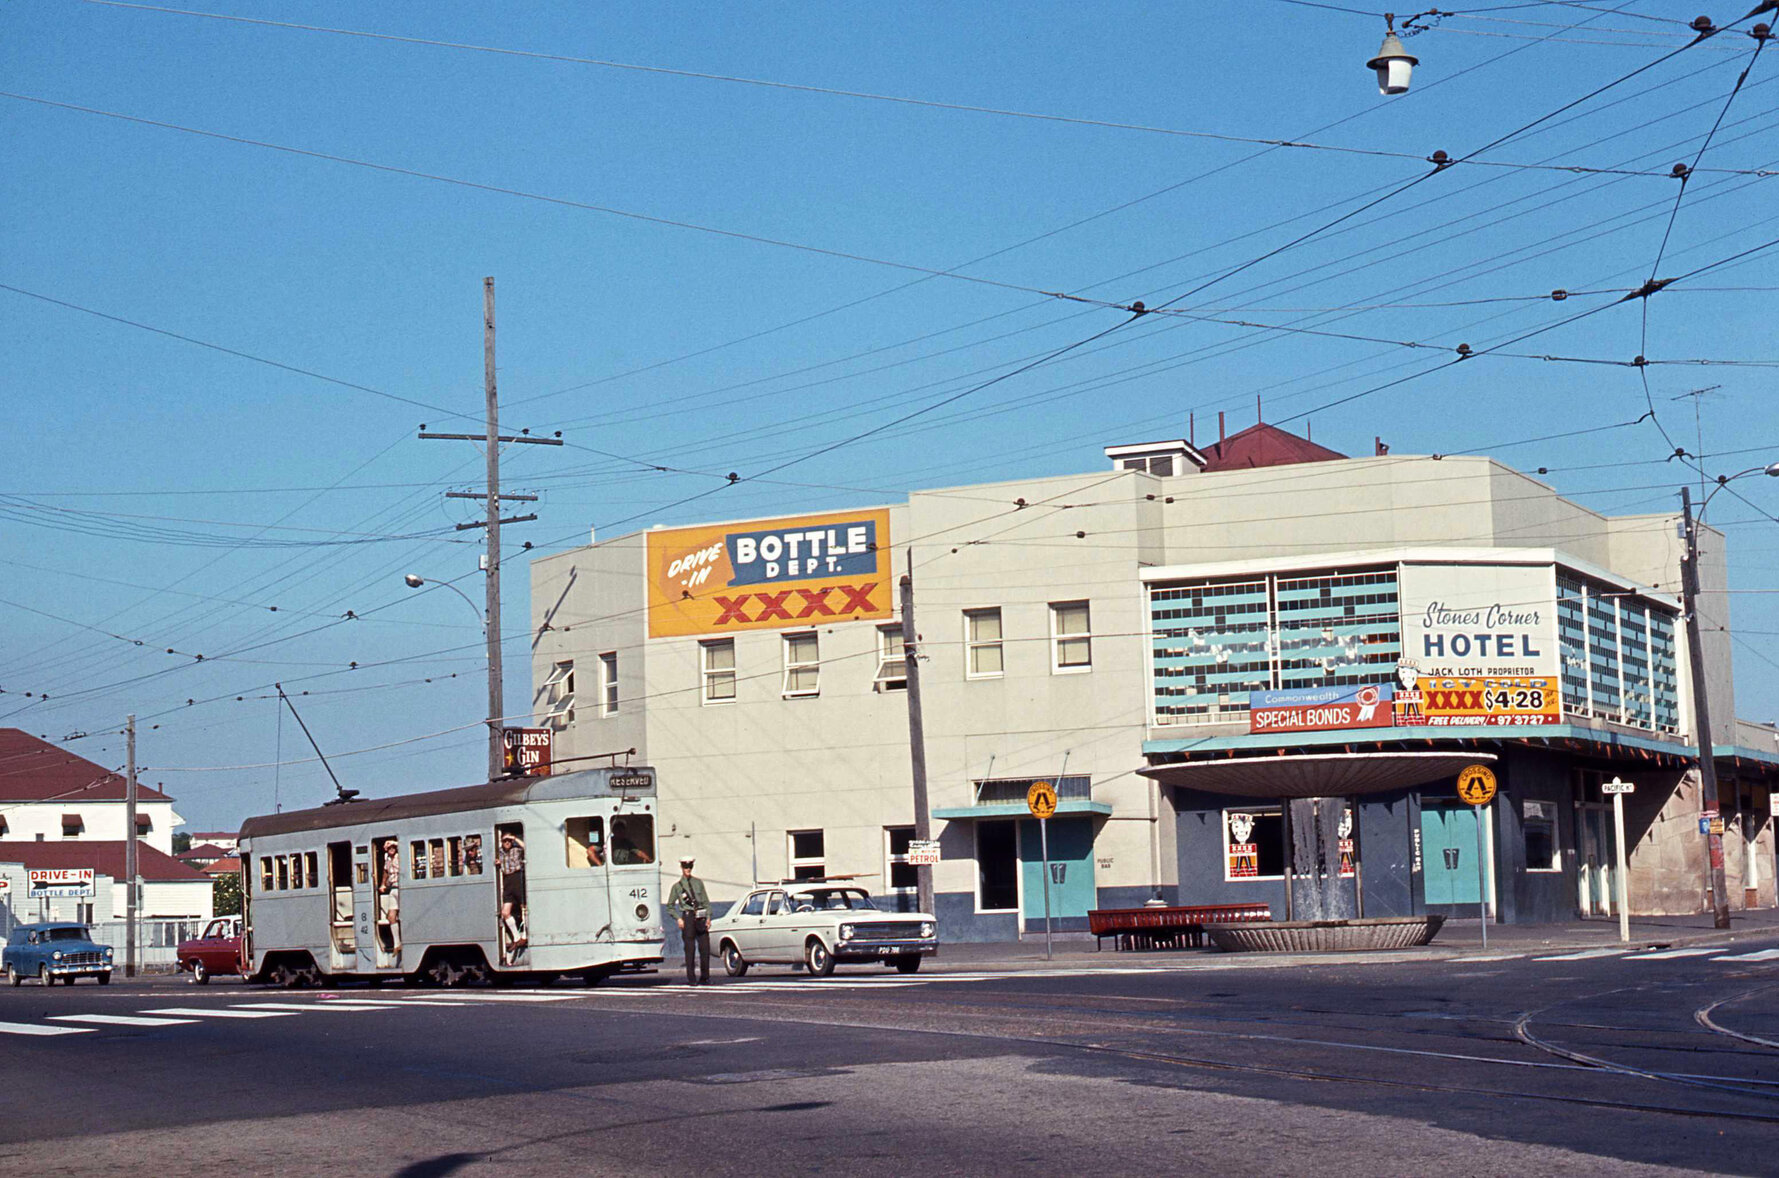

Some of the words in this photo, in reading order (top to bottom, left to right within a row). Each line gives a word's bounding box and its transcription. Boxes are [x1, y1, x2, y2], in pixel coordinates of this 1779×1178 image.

[736, 526, 867, 564] BOTTLE
[667, 542, 724, 578] DRIVE
[766, 556, 842, 578] DEPT.
[713, 582, 880, 626] XXXX
[1423, 601, 1480, 628] Stones
[1486, 603, 1541, 629] Corner
[1423, 633, 1541, 657] HOTEL
[1429, 667, 1453, 676] JACK
[1458, 667, 1482, 675] LOTH
[1487, 667, 1535, 675] PROPRIETOR
[1429, 679, 1476, 689] ICY
[1483, 679, 1548, 689] COLD
[1265, 692, 1340, 704] Commonwealth
[1425, 690, 1484, 710] XXXX
[1256, 709, 1304, 728] SPECIAL
[1307, 707, 1350, 726] BONDS
[1428, 716, 1449, 725] FREE
[503, 729, 549, 749] GILBEY'S
[516, 746, 540, 765] GIN
[610, 776, 649, 786] RESERVED
[1461, 765, 1491, 781] CROSSING
[1413, 828, 1421, 856] PUBLIC
[910, 855, 939, 863] PETROL
[31, 870, 92, 880] DRIVE-IN
[629, 888, 648, 899] 412
